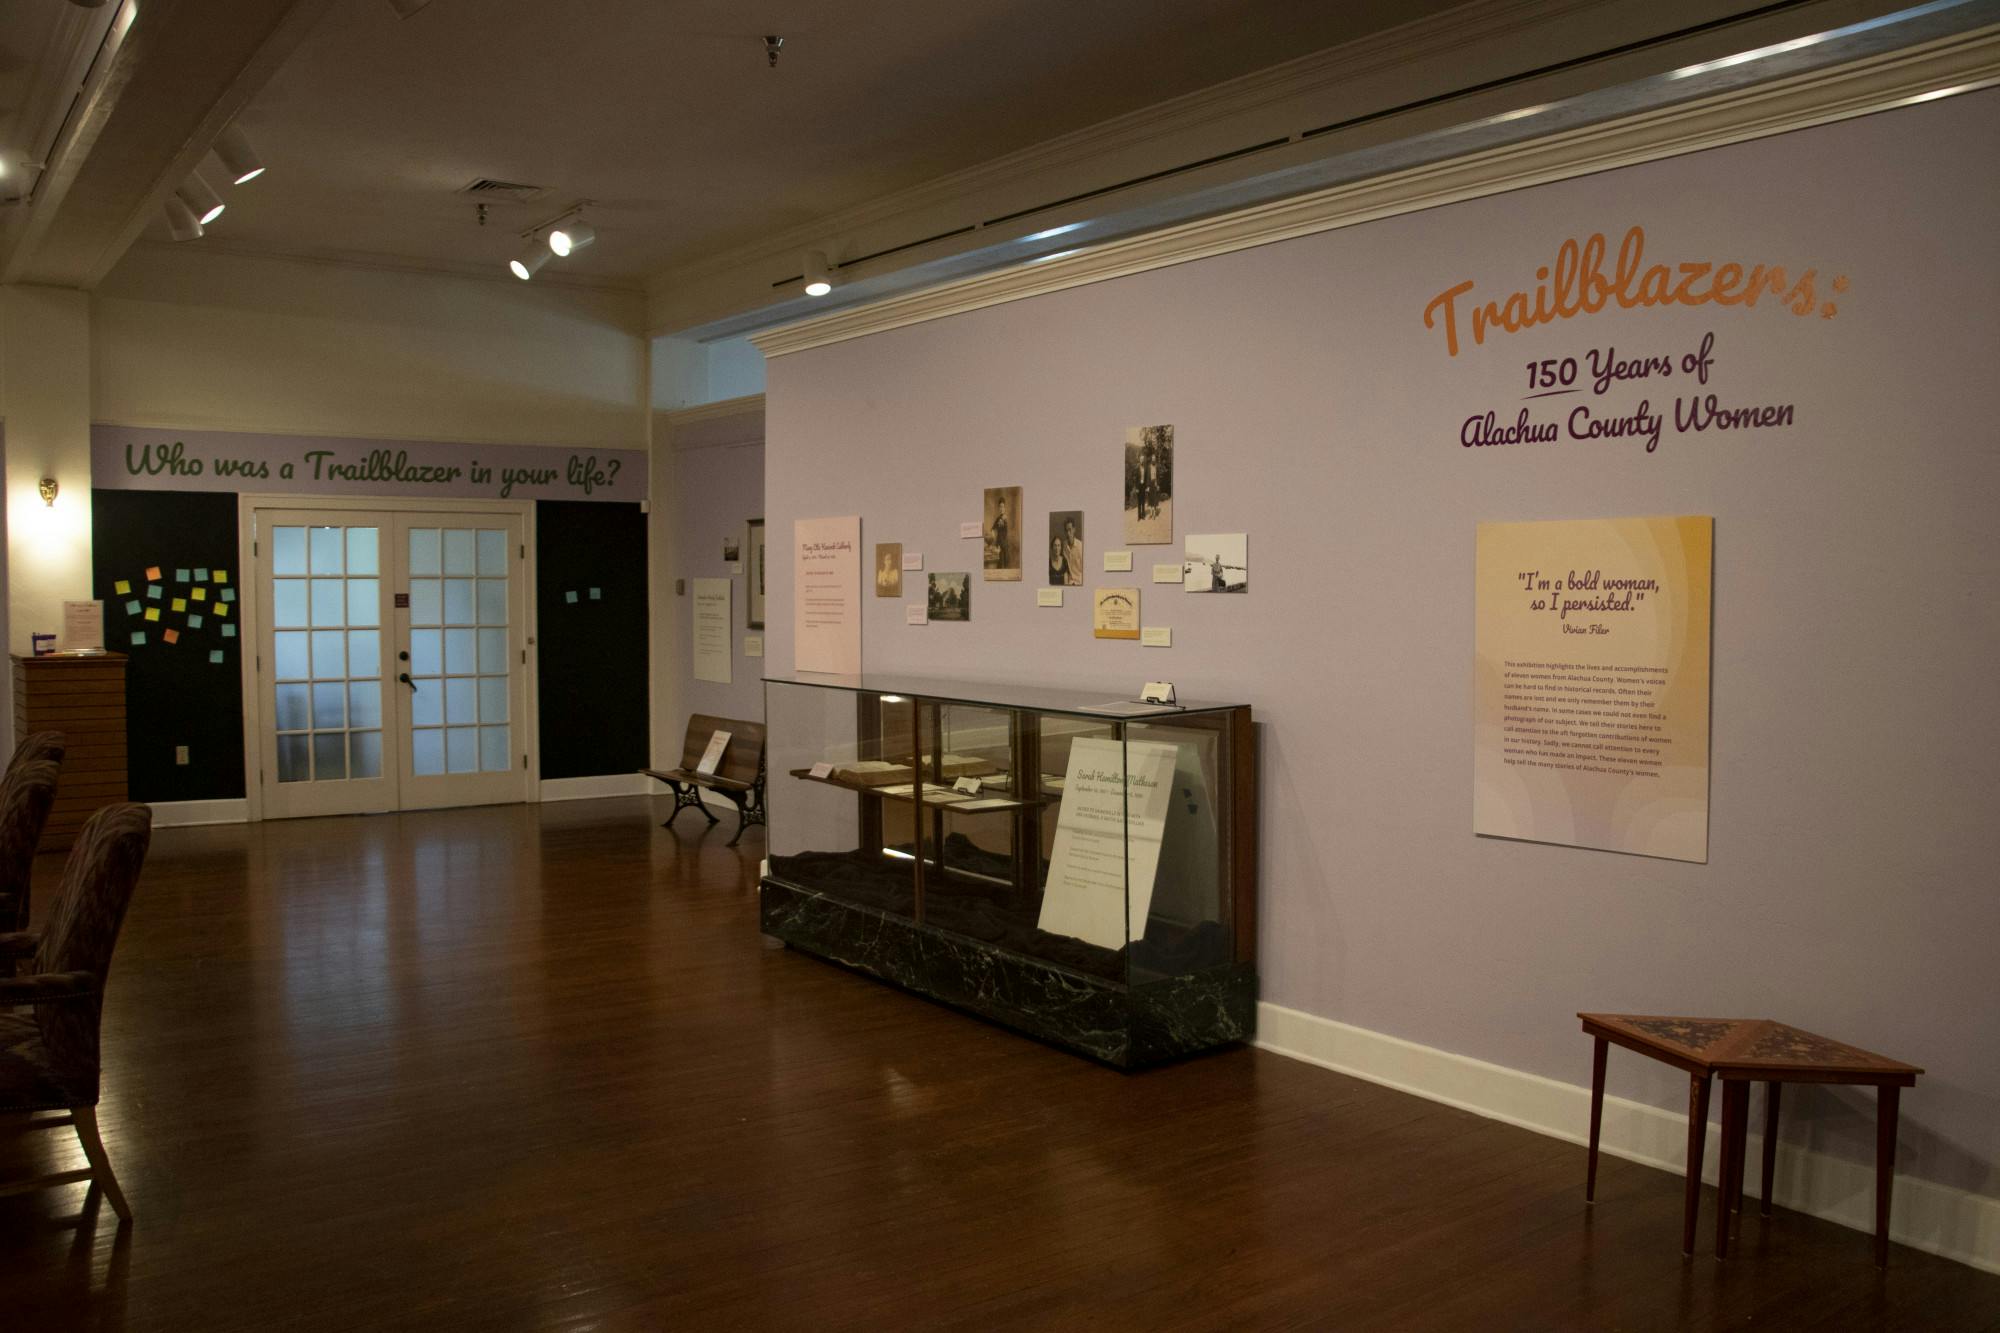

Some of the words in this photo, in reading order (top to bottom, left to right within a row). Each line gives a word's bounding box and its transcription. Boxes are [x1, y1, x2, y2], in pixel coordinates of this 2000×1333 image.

[1423, 225, 1851, 357] Trailblazers:
[1526, 357, 1578, 391] 150
[1586, 346, 1673, 395] Years
[1681, 332, 1714, 384] of
[1461, 410, 1558, 448] Alachua
[1568, 399, 1662, 453] County
[1674, 395, 1794, 432] Women
[125, 444, 203, 477] Who
[214, 458, 268, 479] was
[280, 461, 293, 479] a
[304, 450, 462, 484] Trailblazer
[470, 460, 492, 485] in
[500, 466, 559, 498] your
[566, 457, 622, 495] life?
[1519, 571, 1550, 591] "I'm
[1555, 580, 1562, 590] a
[1568, 570, 1600, 590] bold
[1603, 579, 1659, 593] woman,
[1530, 599, 1545, 610] so
[1550, 592, 1559, 610] I
[1560, 591, 1645, 619] persisted."
[1077, 769, 1095, 780] Sarah
